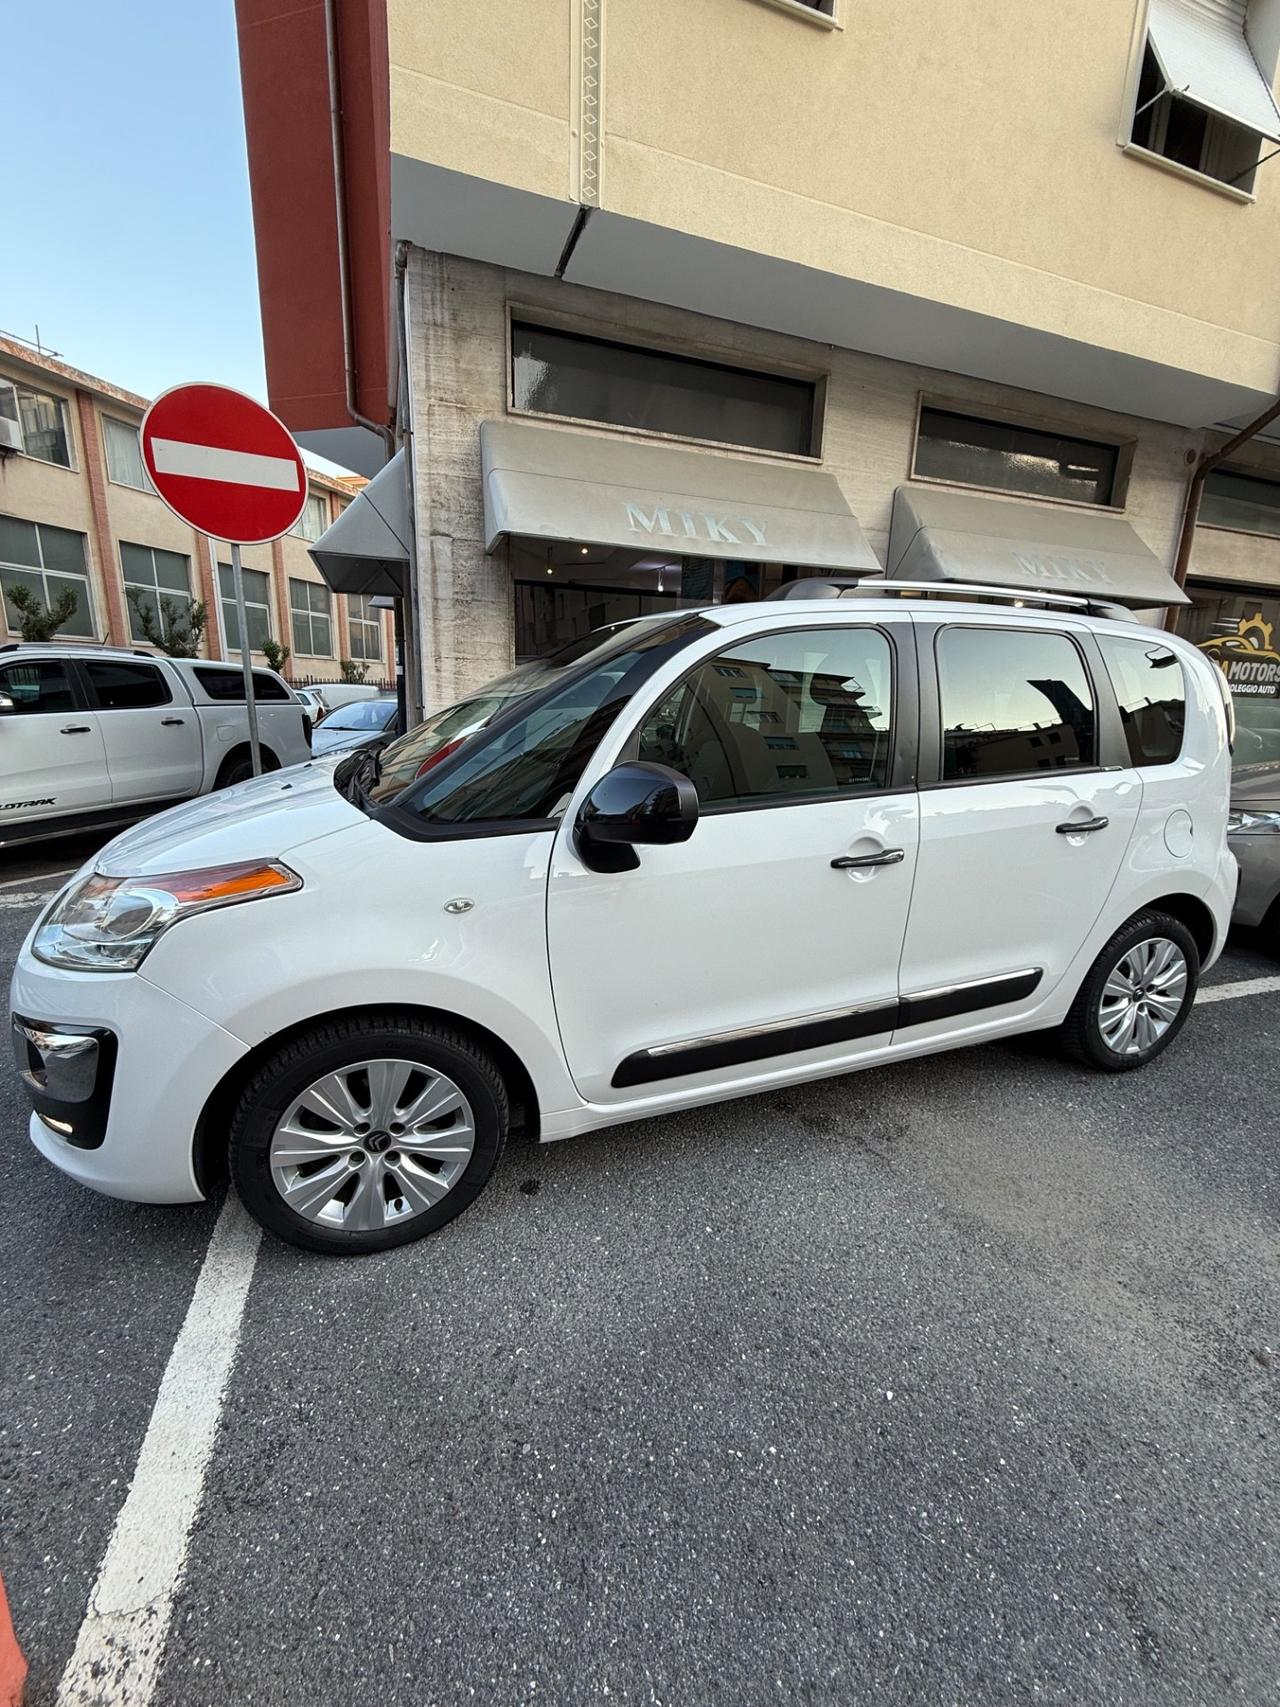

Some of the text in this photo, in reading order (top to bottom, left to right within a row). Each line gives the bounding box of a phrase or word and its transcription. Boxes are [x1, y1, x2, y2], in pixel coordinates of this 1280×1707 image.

[622, 500, 771, 546] MIKY
[1228, 683, 1276, 694] OLEGGIO AUTO
